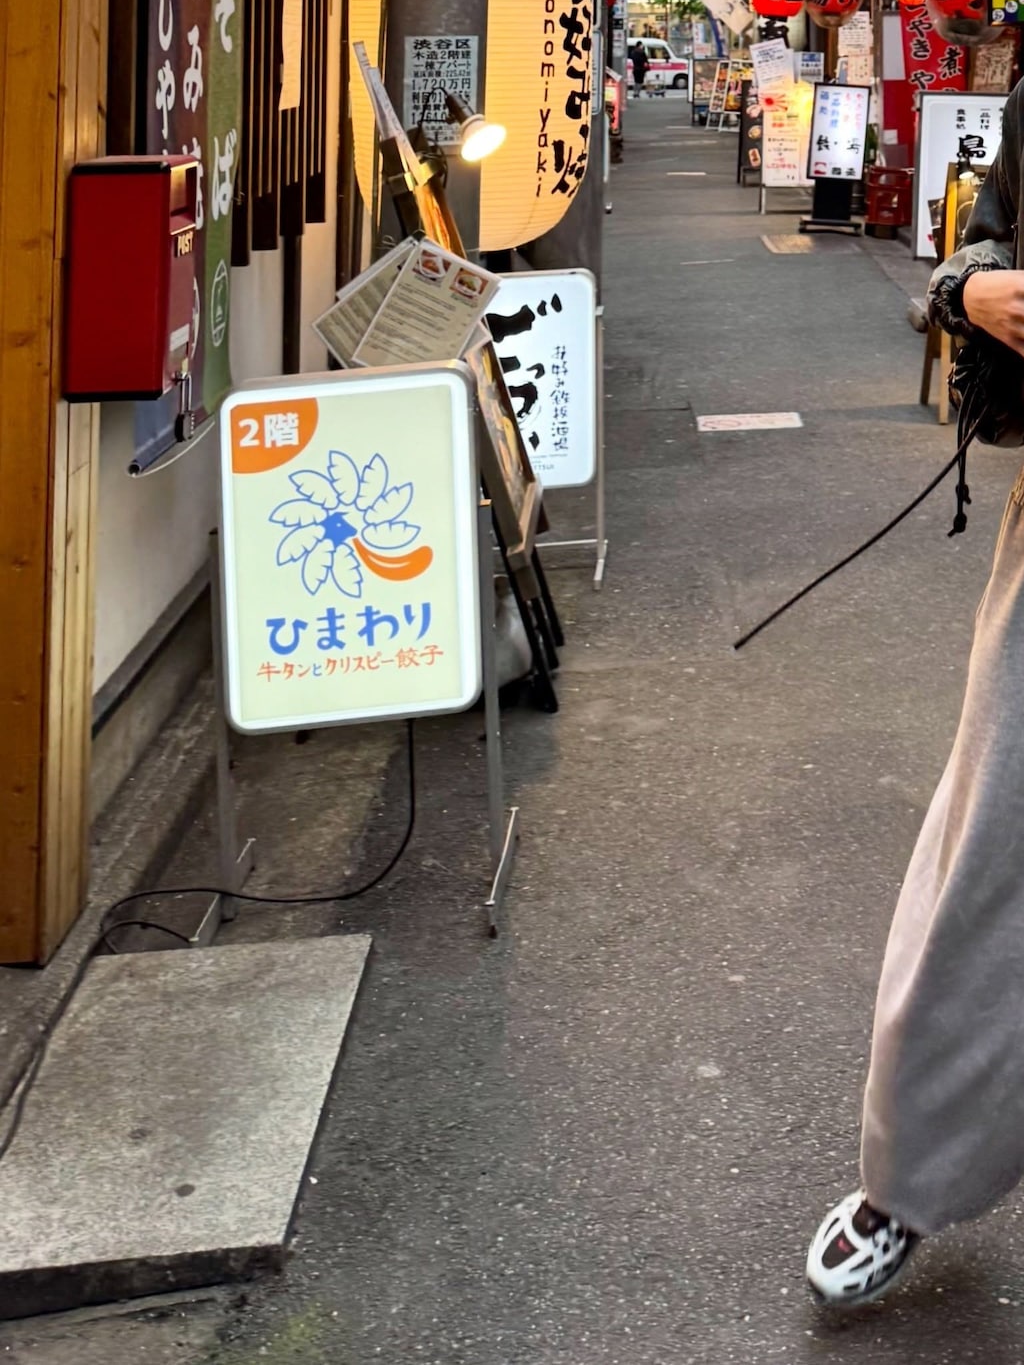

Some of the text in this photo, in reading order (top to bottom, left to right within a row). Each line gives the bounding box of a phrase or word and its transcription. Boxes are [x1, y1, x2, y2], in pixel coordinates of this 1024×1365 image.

[413, 38, 472, 50] 渋谷区
[177, 232, 194, 258] POST
[238, 412, 300, 449] 2階
[265, 601, 433, 656] ひまわり
[256, 644, 444, 683] 牛タンとクリスピー餃子
